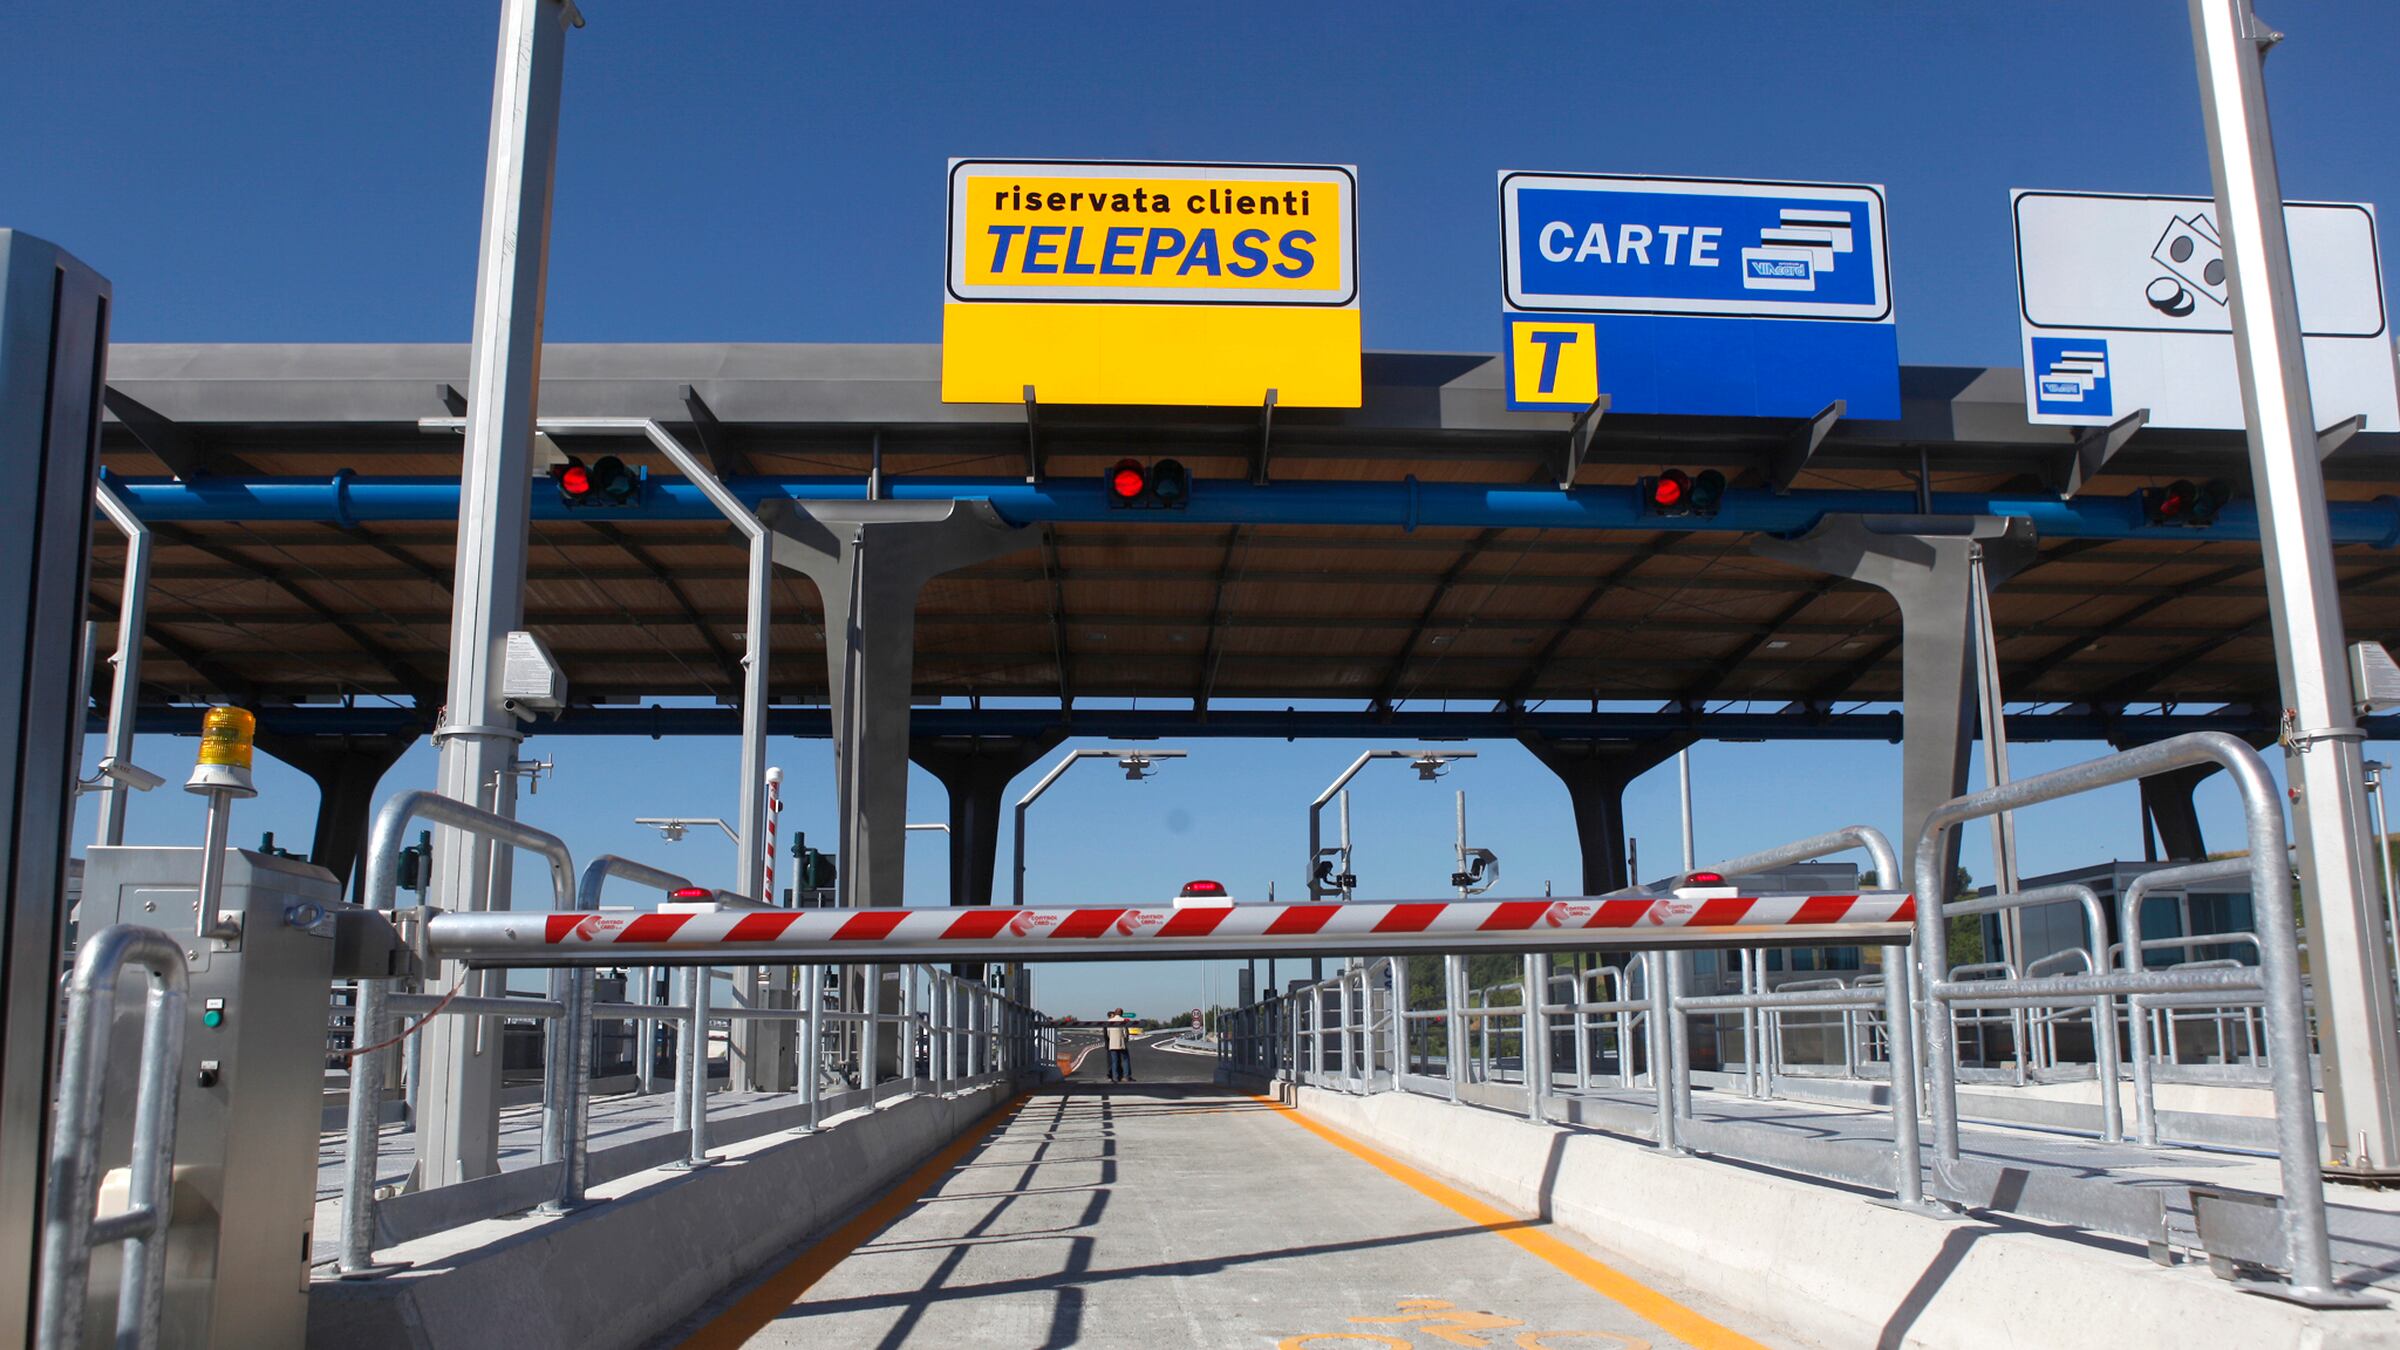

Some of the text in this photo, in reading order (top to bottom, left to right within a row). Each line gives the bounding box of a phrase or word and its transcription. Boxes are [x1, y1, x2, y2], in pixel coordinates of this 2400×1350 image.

[995, 185, 1310, 216] riservata clienti
[987, 225, 1317, 279] TELEPASS
[1538, 221, 1723, 267] CARTE
[1530, 331, 1578, 393] T
